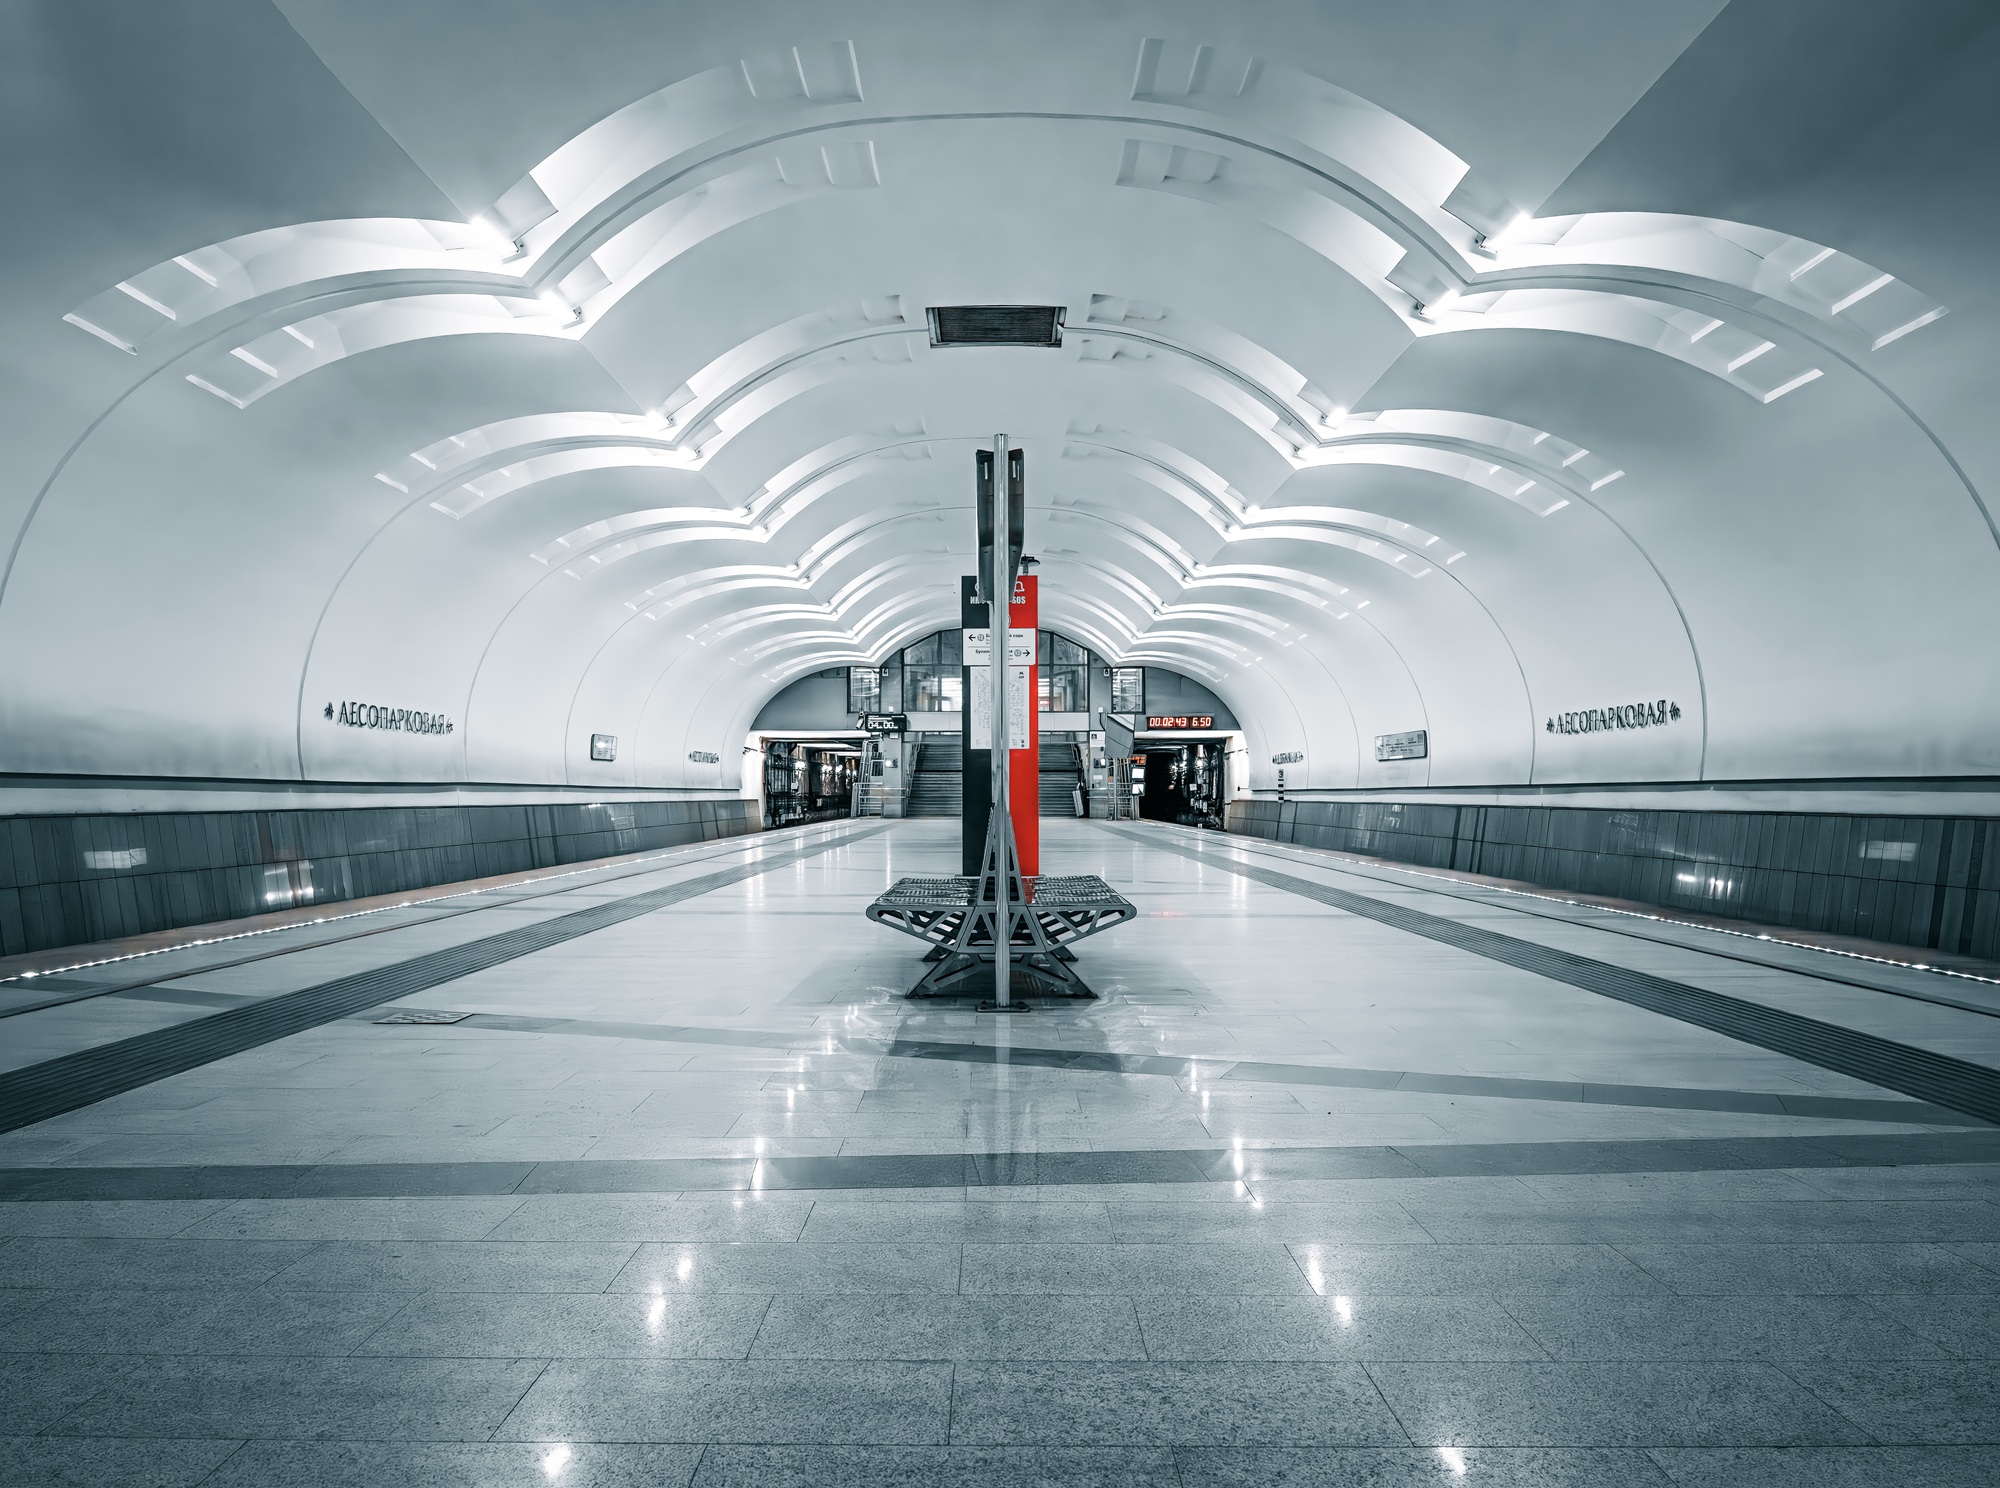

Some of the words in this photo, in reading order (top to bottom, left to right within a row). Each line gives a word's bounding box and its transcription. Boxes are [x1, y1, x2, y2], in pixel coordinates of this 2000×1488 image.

[1012, 596, 1026, 604] SOS
[338, 700, 445, 735] ЛЕСОПАРКОВАЯ
[1556, 699, 1667, 734] ЛЕСОПАРКОВАЯ
[1192, 717, 1212, 727] 6.50
[1278, 770, 1284, 778] 3
